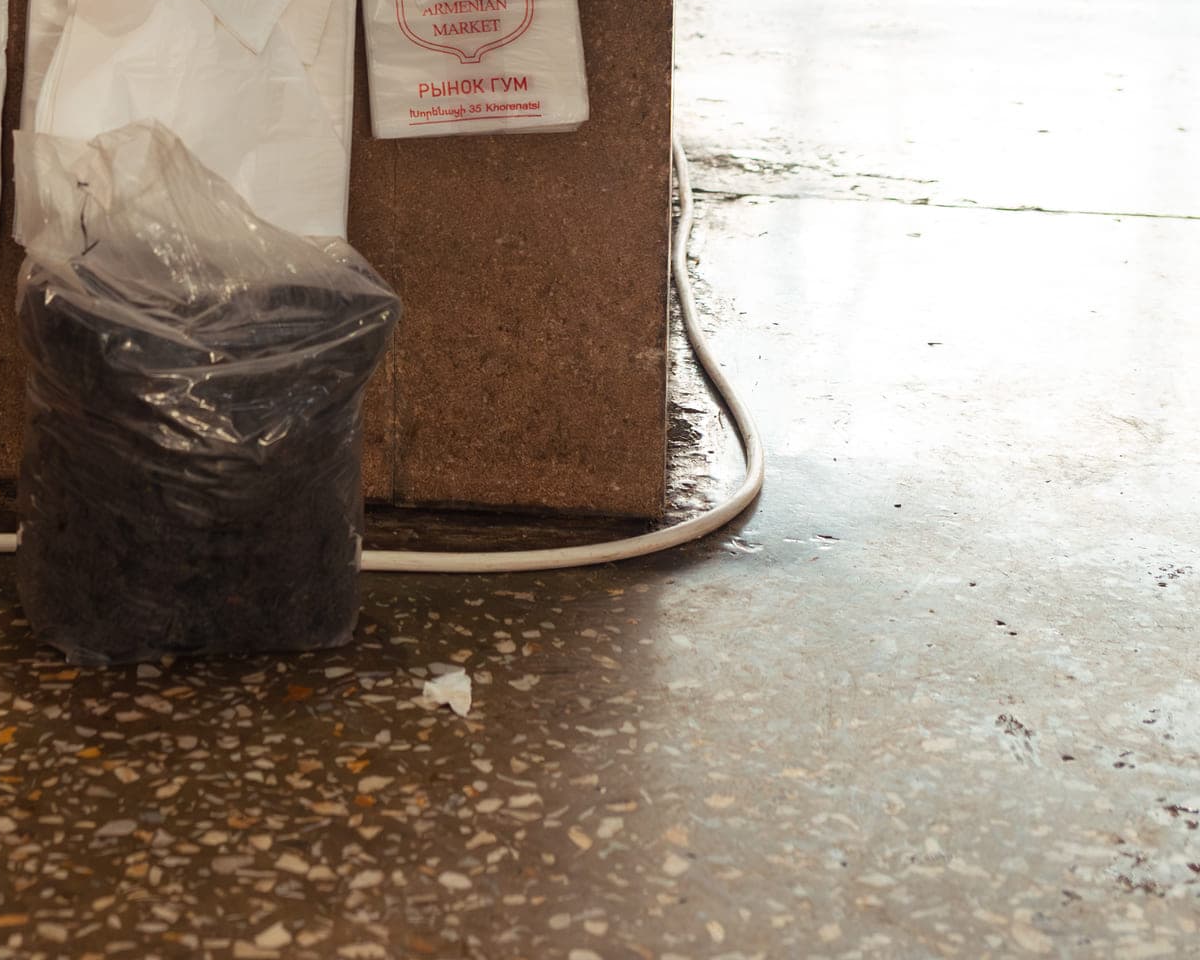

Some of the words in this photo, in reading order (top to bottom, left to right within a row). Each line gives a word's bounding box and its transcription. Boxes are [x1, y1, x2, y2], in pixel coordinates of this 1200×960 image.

[432, 19, 502, 37] MARKET
[418, 78, 485, 99] РЫНОК
[489, 76, 529, 93] ГУМ
[469, 103, 482, 114] 35
[486, 100, 541, 113] Khorenatsi
